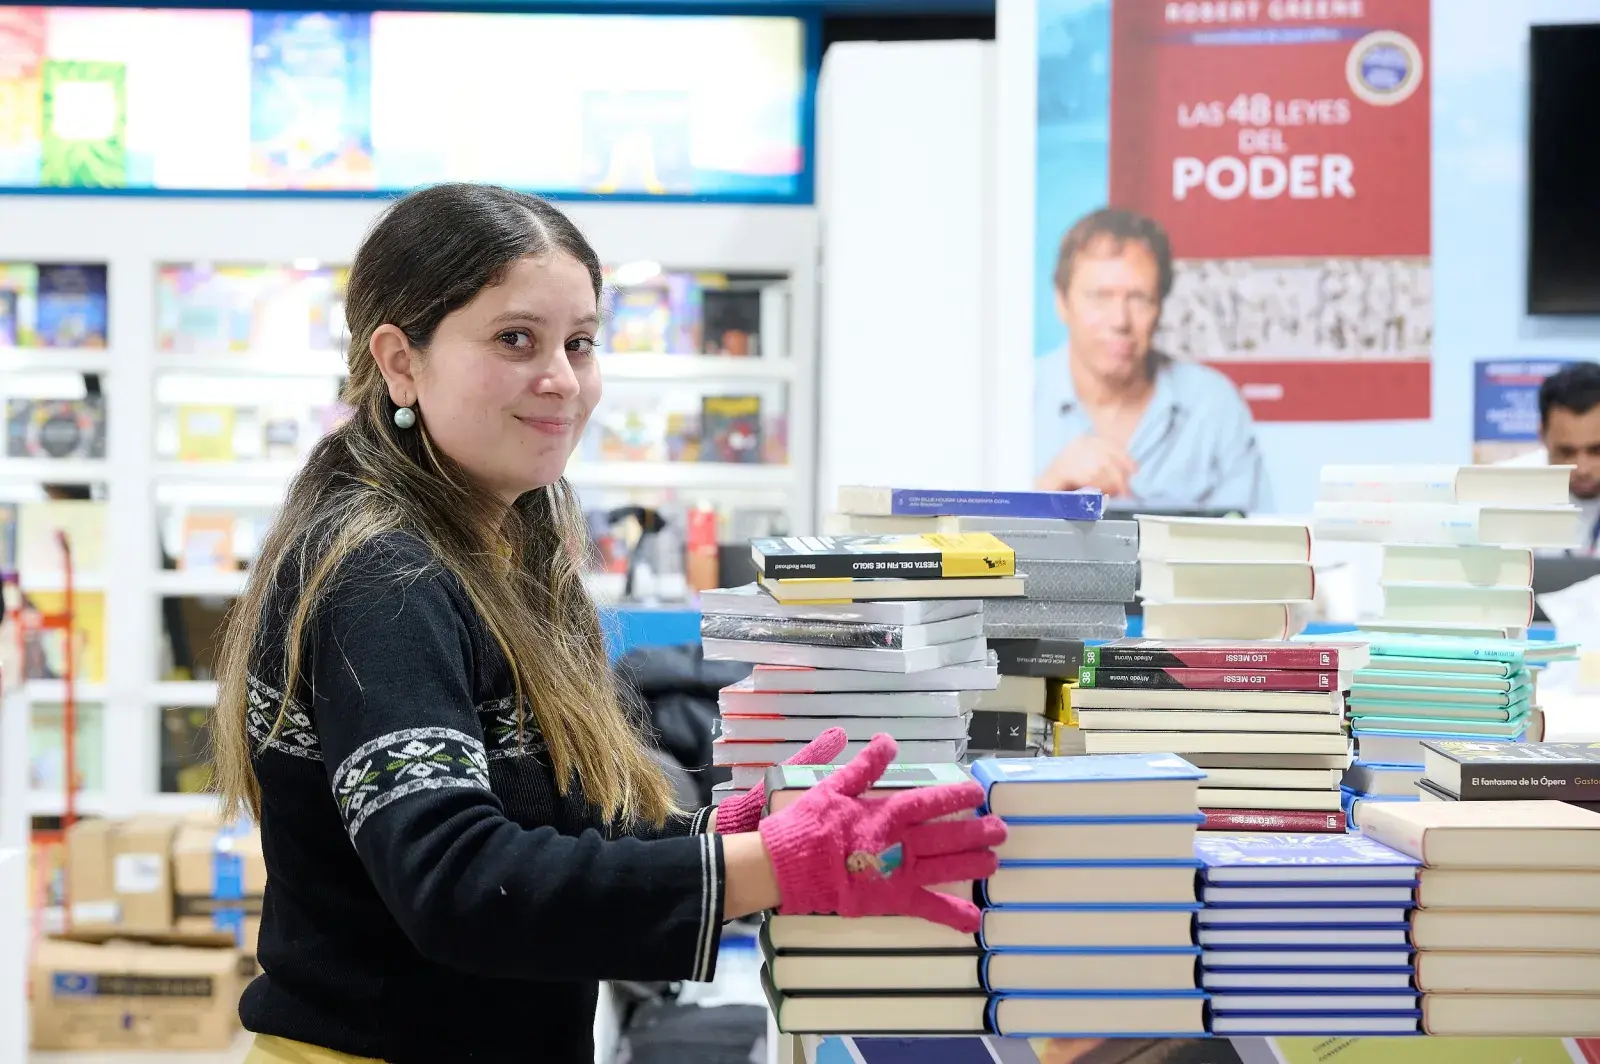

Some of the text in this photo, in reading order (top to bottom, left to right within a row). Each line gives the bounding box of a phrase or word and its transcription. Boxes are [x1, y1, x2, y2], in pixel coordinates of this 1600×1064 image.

[1164, 0, 1364, 23] ROBERT GREENE
[1177, 93, 1351, 128] LAS 48 LEYES
[1238, 128, 1288, 154] DEL
[1172, 154, 1355, 200] PODER
[852, 562, 875, 570] SIGLO
[875, 562, 886, 570] DE
[899, 561, 913, 569] DEL
[914, 561, 939, 569] FIESTA
[1087, 651, 1095, 664] 38
[1225, 654, 1268, 662] LEO MESSI
[1082, 671, 1091, 684] 38
[1250, 675, 1266, 683] LEO
[1009, 725, 1019, 737] K
[1471, 777, 1480, 786] El
[1481, 777, 1518, 786] fantasma
[1519, 777, 1530, 786] de
[1531, 777, 1539, 786] la
[1540, 775, 1567, 788] Ópera
[1258, 816, 1274, 825] LEO
